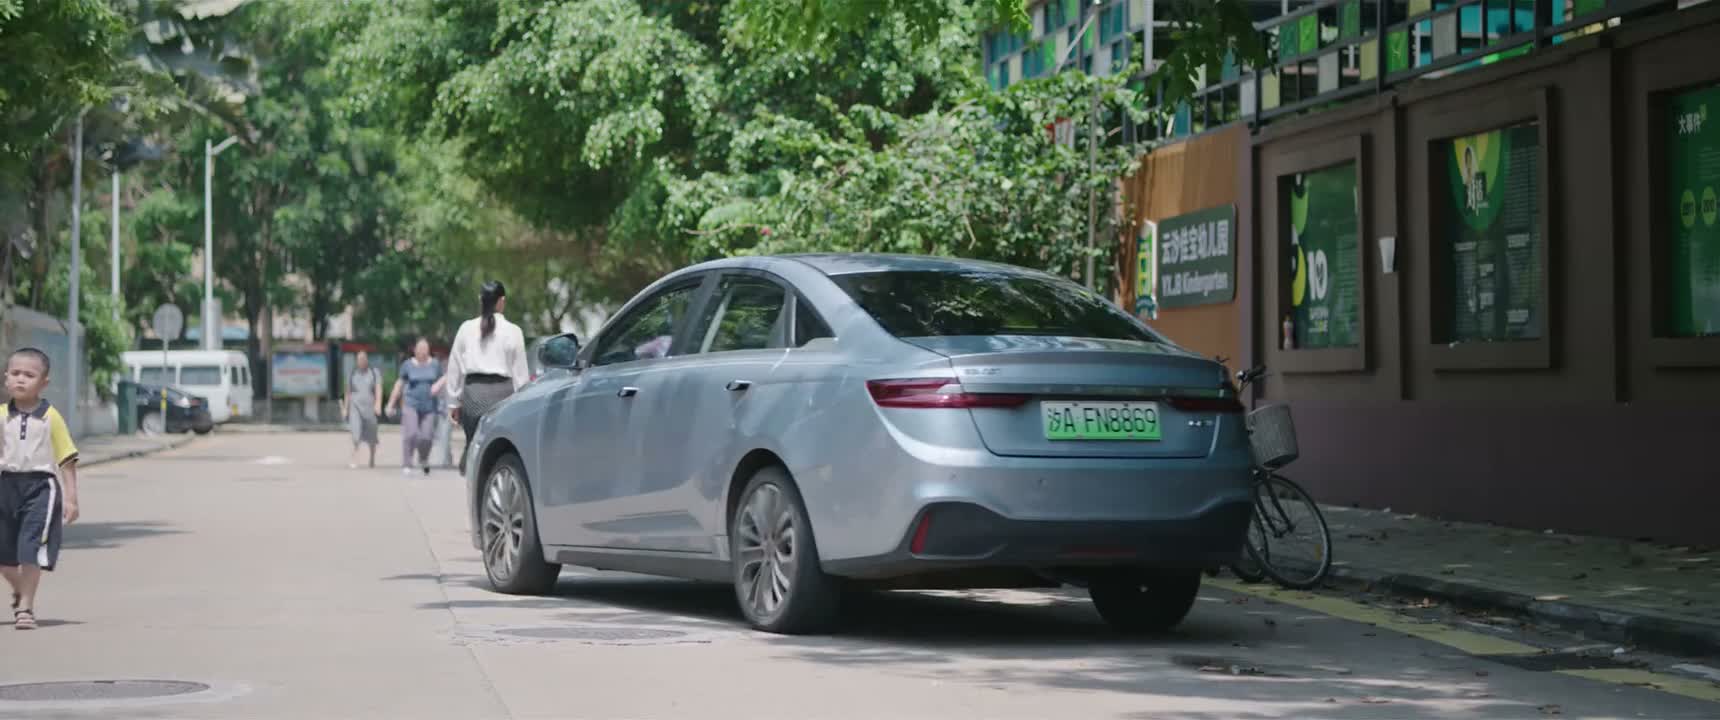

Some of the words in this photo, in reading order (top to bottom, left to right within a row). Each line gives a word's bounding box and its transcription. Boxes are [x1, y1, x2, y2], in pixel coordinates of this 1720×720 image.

[1161, 219, 1228, 264] 云沙佳宝幼儿园
[1183, 268, 1228, 296] Kindergarten
[1307, 249, 1328, 301] 10
